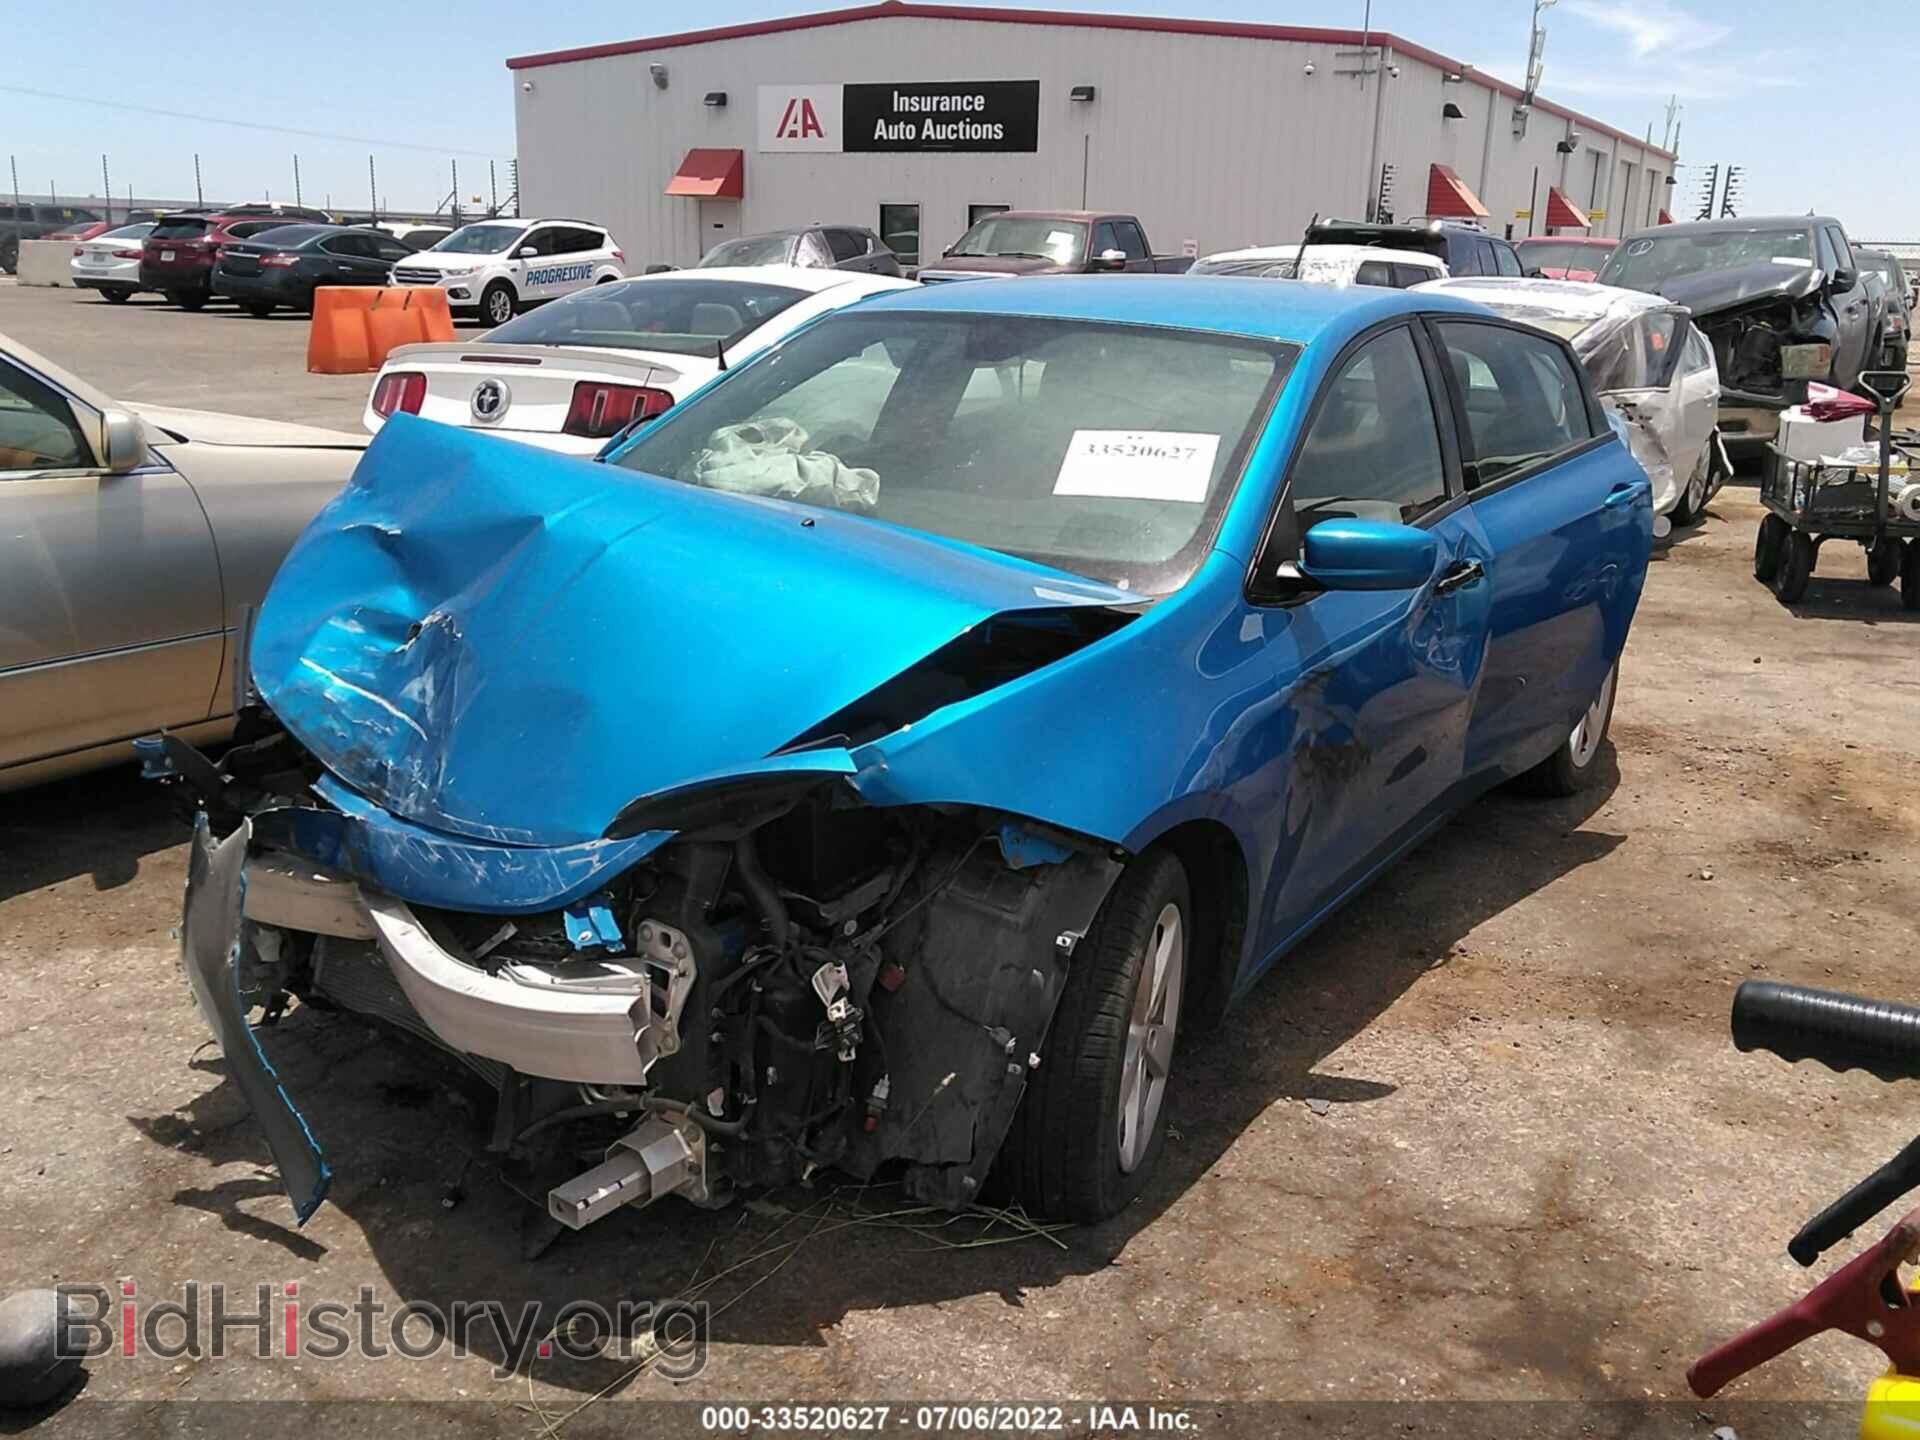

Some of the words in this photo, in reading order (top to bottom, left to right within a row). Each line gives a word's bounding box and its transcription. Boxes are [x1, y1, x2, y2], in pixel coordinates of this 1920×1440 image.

[893, 90, 985, 112] Insurance
[873, 118, 916, 141] Auto
[921, 117, 1004, 141] Auctions
[525, 264, 593, 286] PROGRESSIVE
[1083, 444, 1198, 460] 33520627
